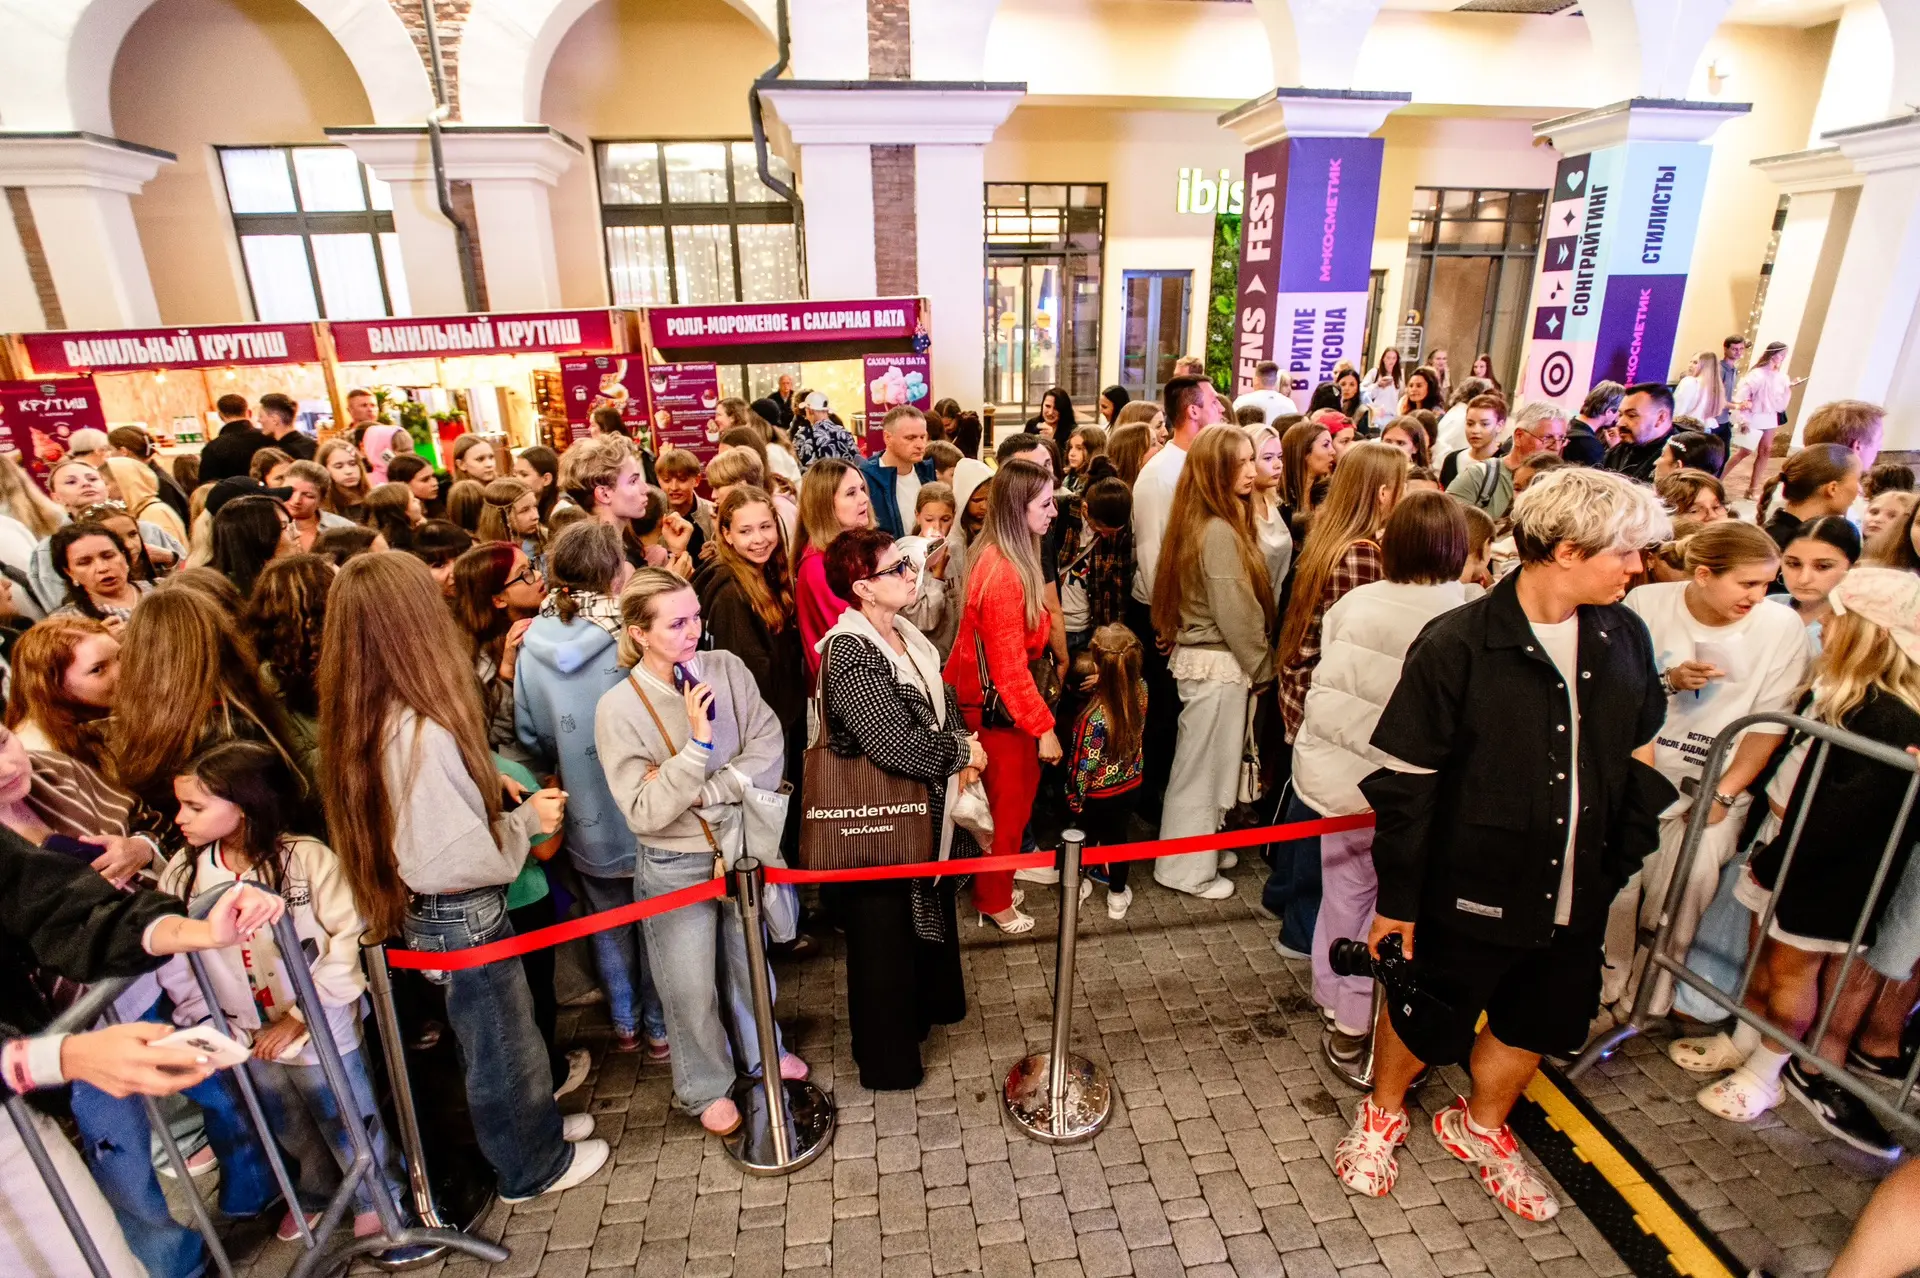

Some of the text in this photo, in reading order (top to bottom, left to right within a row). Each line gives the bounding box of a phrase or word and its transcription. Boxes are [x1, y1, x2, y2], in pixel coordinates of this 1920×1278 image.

[1641, 165, 1677, 265] СТИЛИСТЫ
[1571, 184, 1609, 316] СОНГРАЙТИНГ
[1238, 172, 1277, 395] EENS FEST
[366, 316, 582, 354] ВАНИЛЬНЫЙ КРУТИШ
[666, 312, 789, 337] РОЛЛ-МОРОЖЕНОЕ
[803, 311, 871, 331] САХАРНАЯ
[873, 308, 905, 328] ВАТА
[1290, 308, 1316, 372] РИТМЕ
[62, 329, 288, 367] ВАНИЛЬНЫЙ КРУТИШ
[866, 356, 927, 366] САХАРНАЯ ВАТА
[1319, 307, 1347, 382] ЕКСОНА
[18, 397, 88, 412] КРУТИШ
[1656, 736, 1709, 757] ПОСЛЕ ДЕДЛА
[806, 801, 928, 820] alexanderwang
